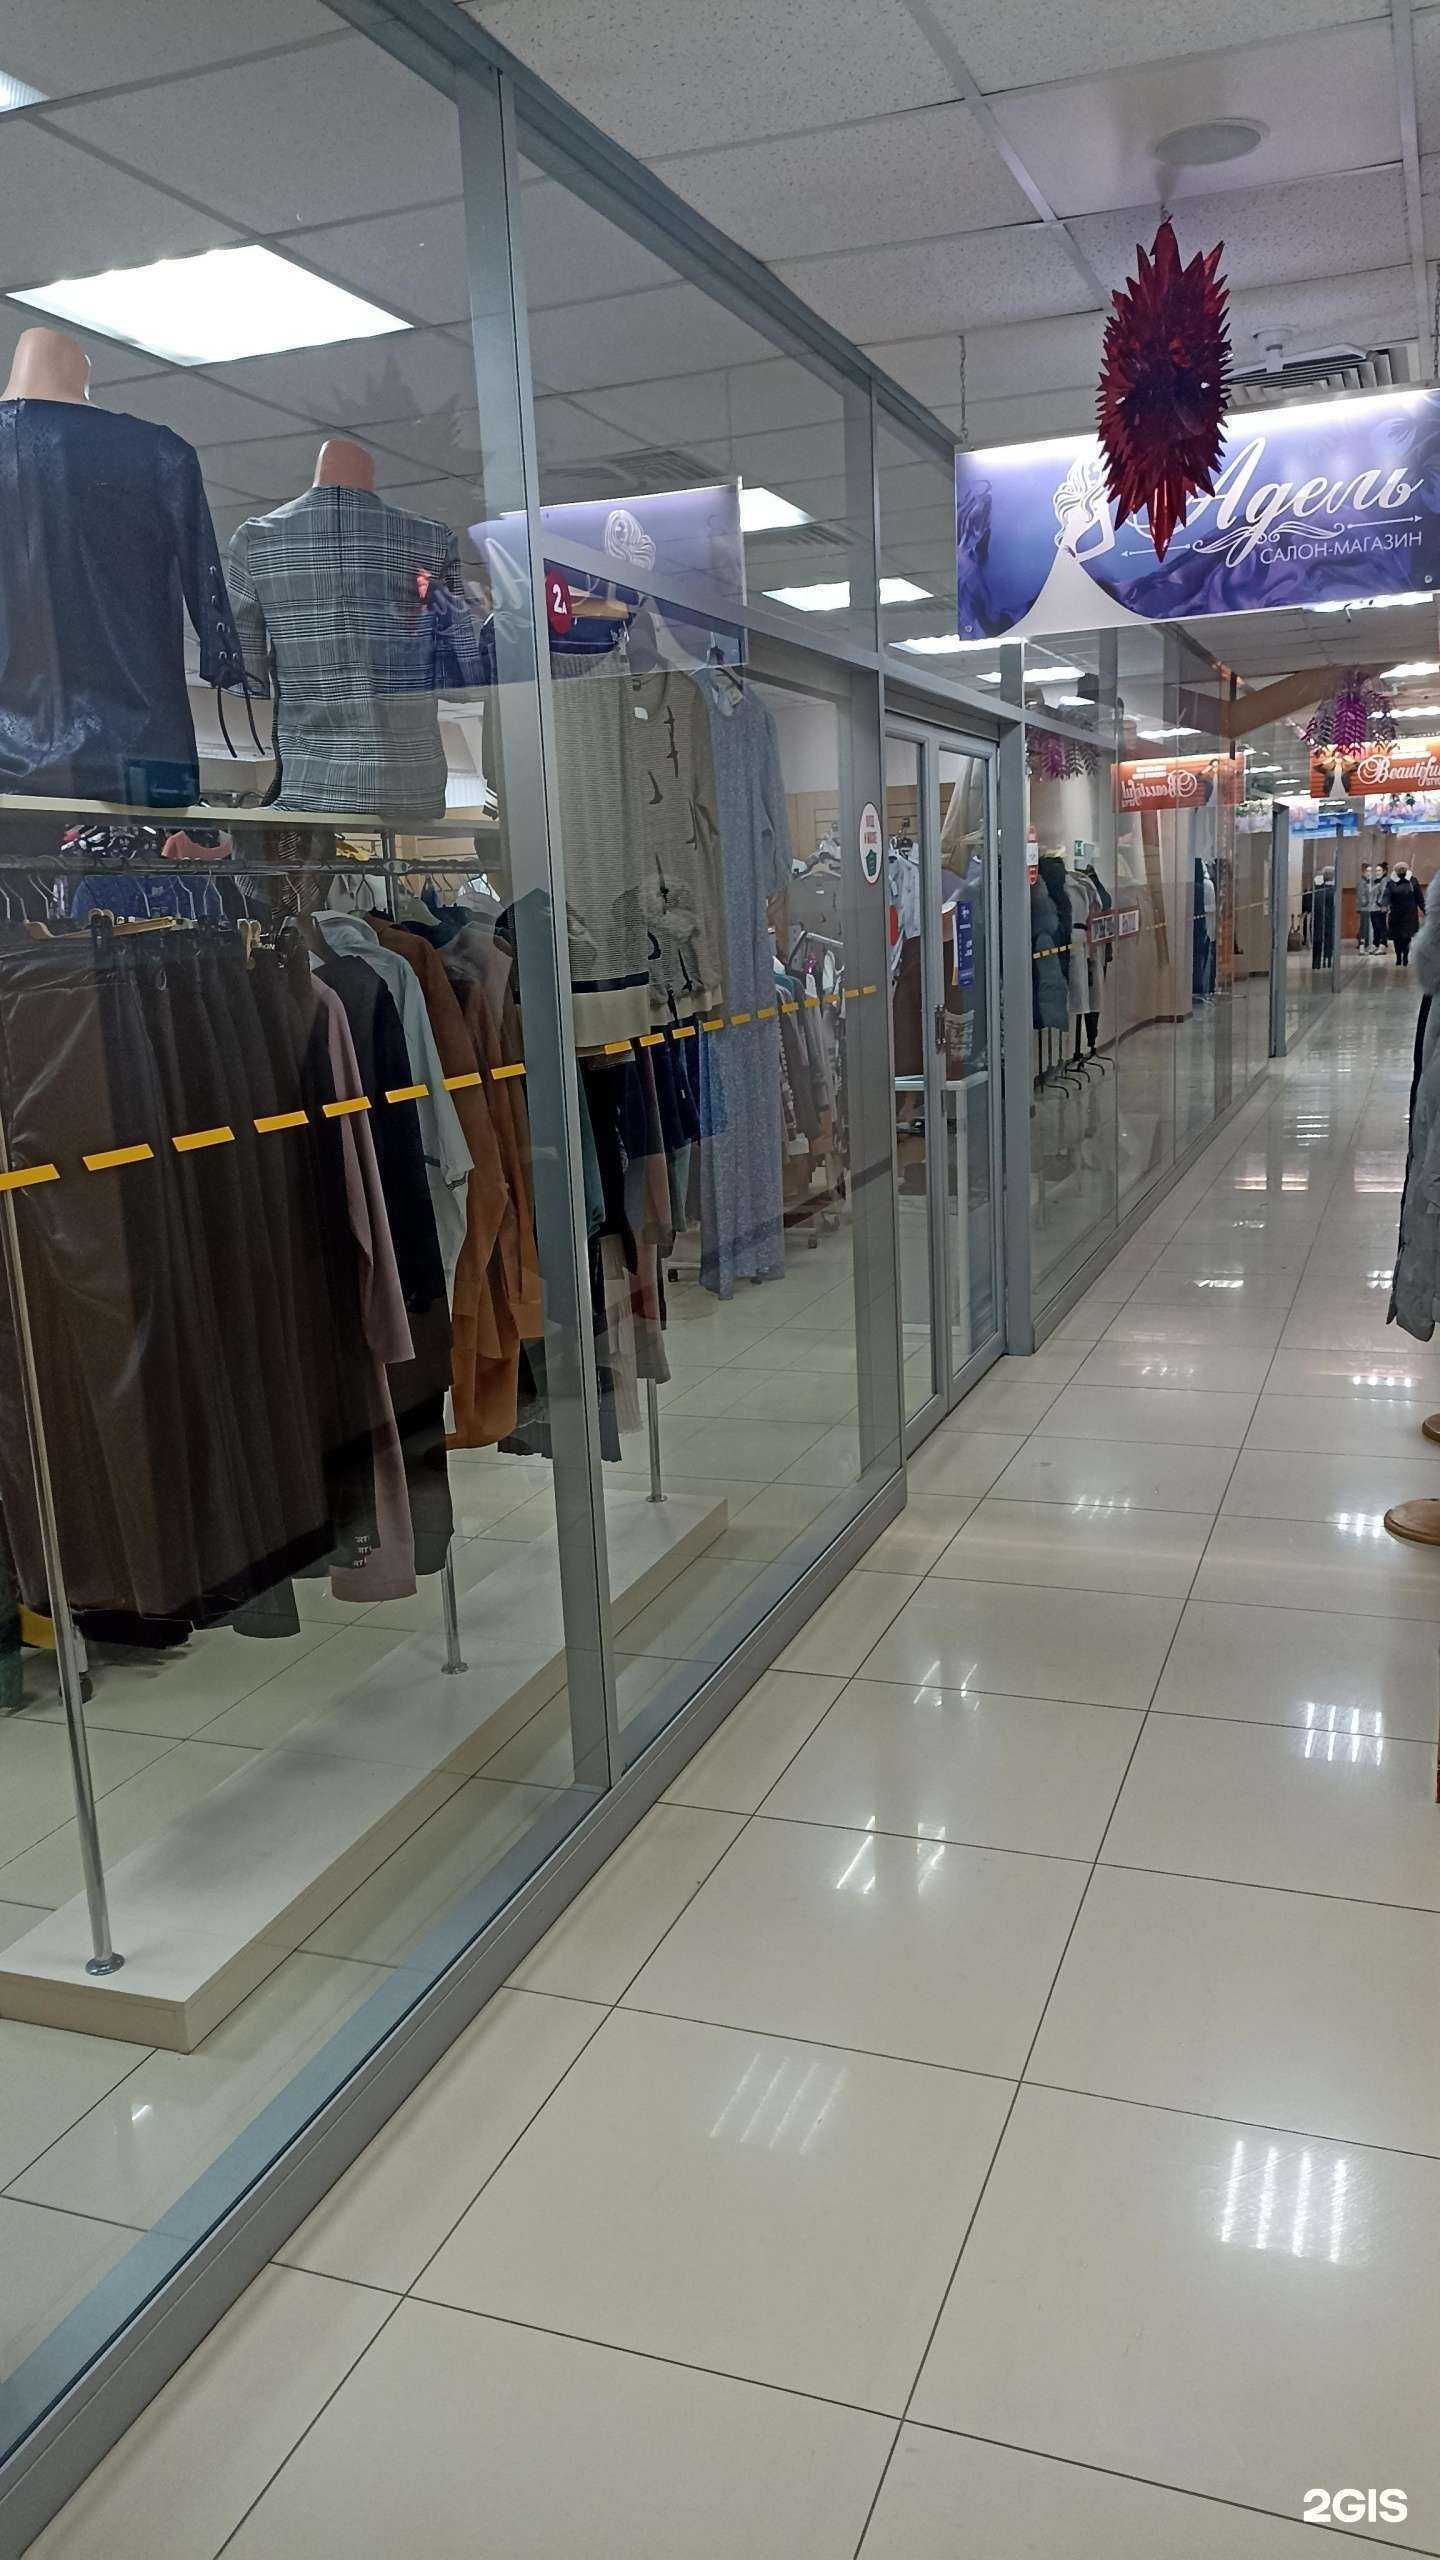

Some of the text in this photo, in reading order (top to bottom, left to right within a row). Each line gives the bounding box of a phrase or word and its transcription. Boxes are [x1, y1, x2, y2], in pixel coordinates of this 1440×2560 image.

[1178, 437, 1424, 568] Адель
[1260, 531, 1423, 565] САЛОН-МАГАЗИН
[1357, 753, 1440, 787] Beautifu
